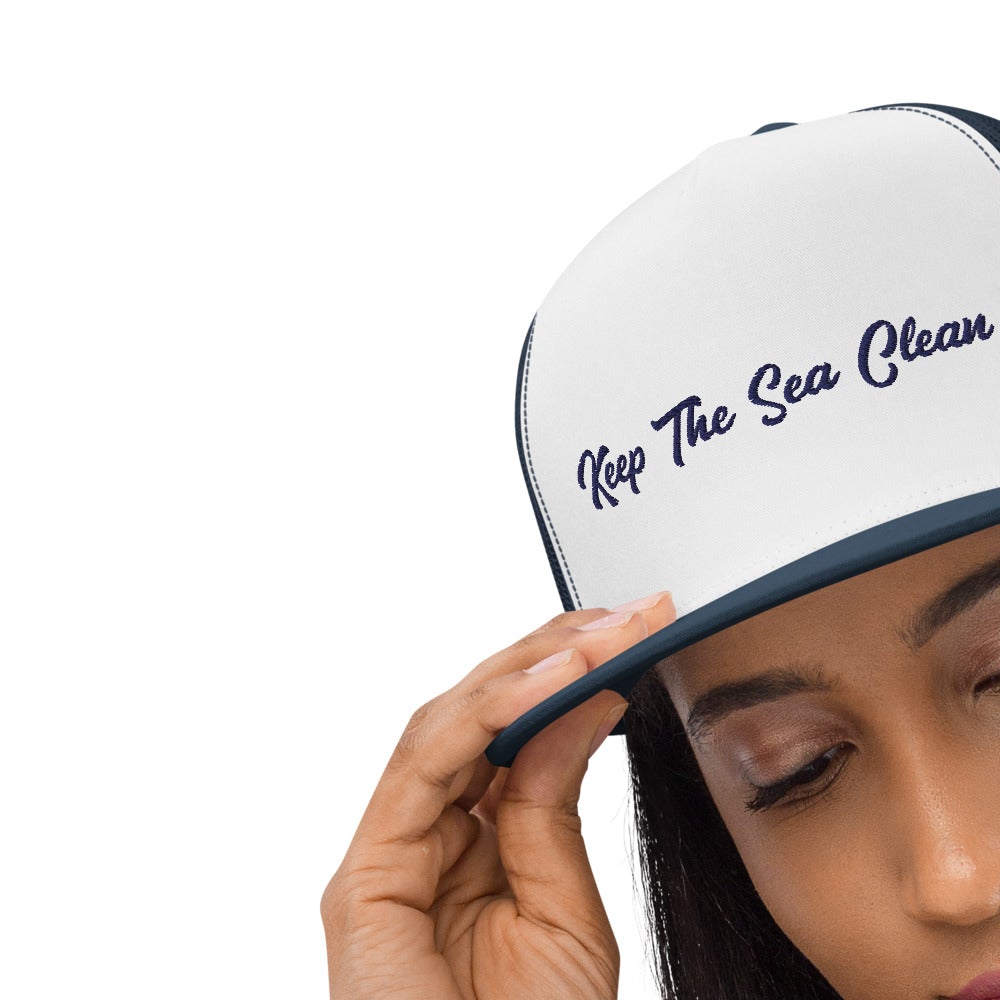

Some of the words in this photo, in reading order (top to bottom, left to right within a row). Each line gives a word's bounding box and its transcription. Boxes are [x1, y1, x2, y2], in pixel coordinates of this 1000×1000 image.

[577, 445, 646, 511] Keep
[651, 394, 737, 468] The
[747, 361, 842, 427] Sea
[857, 313, 995, 389] Clean
